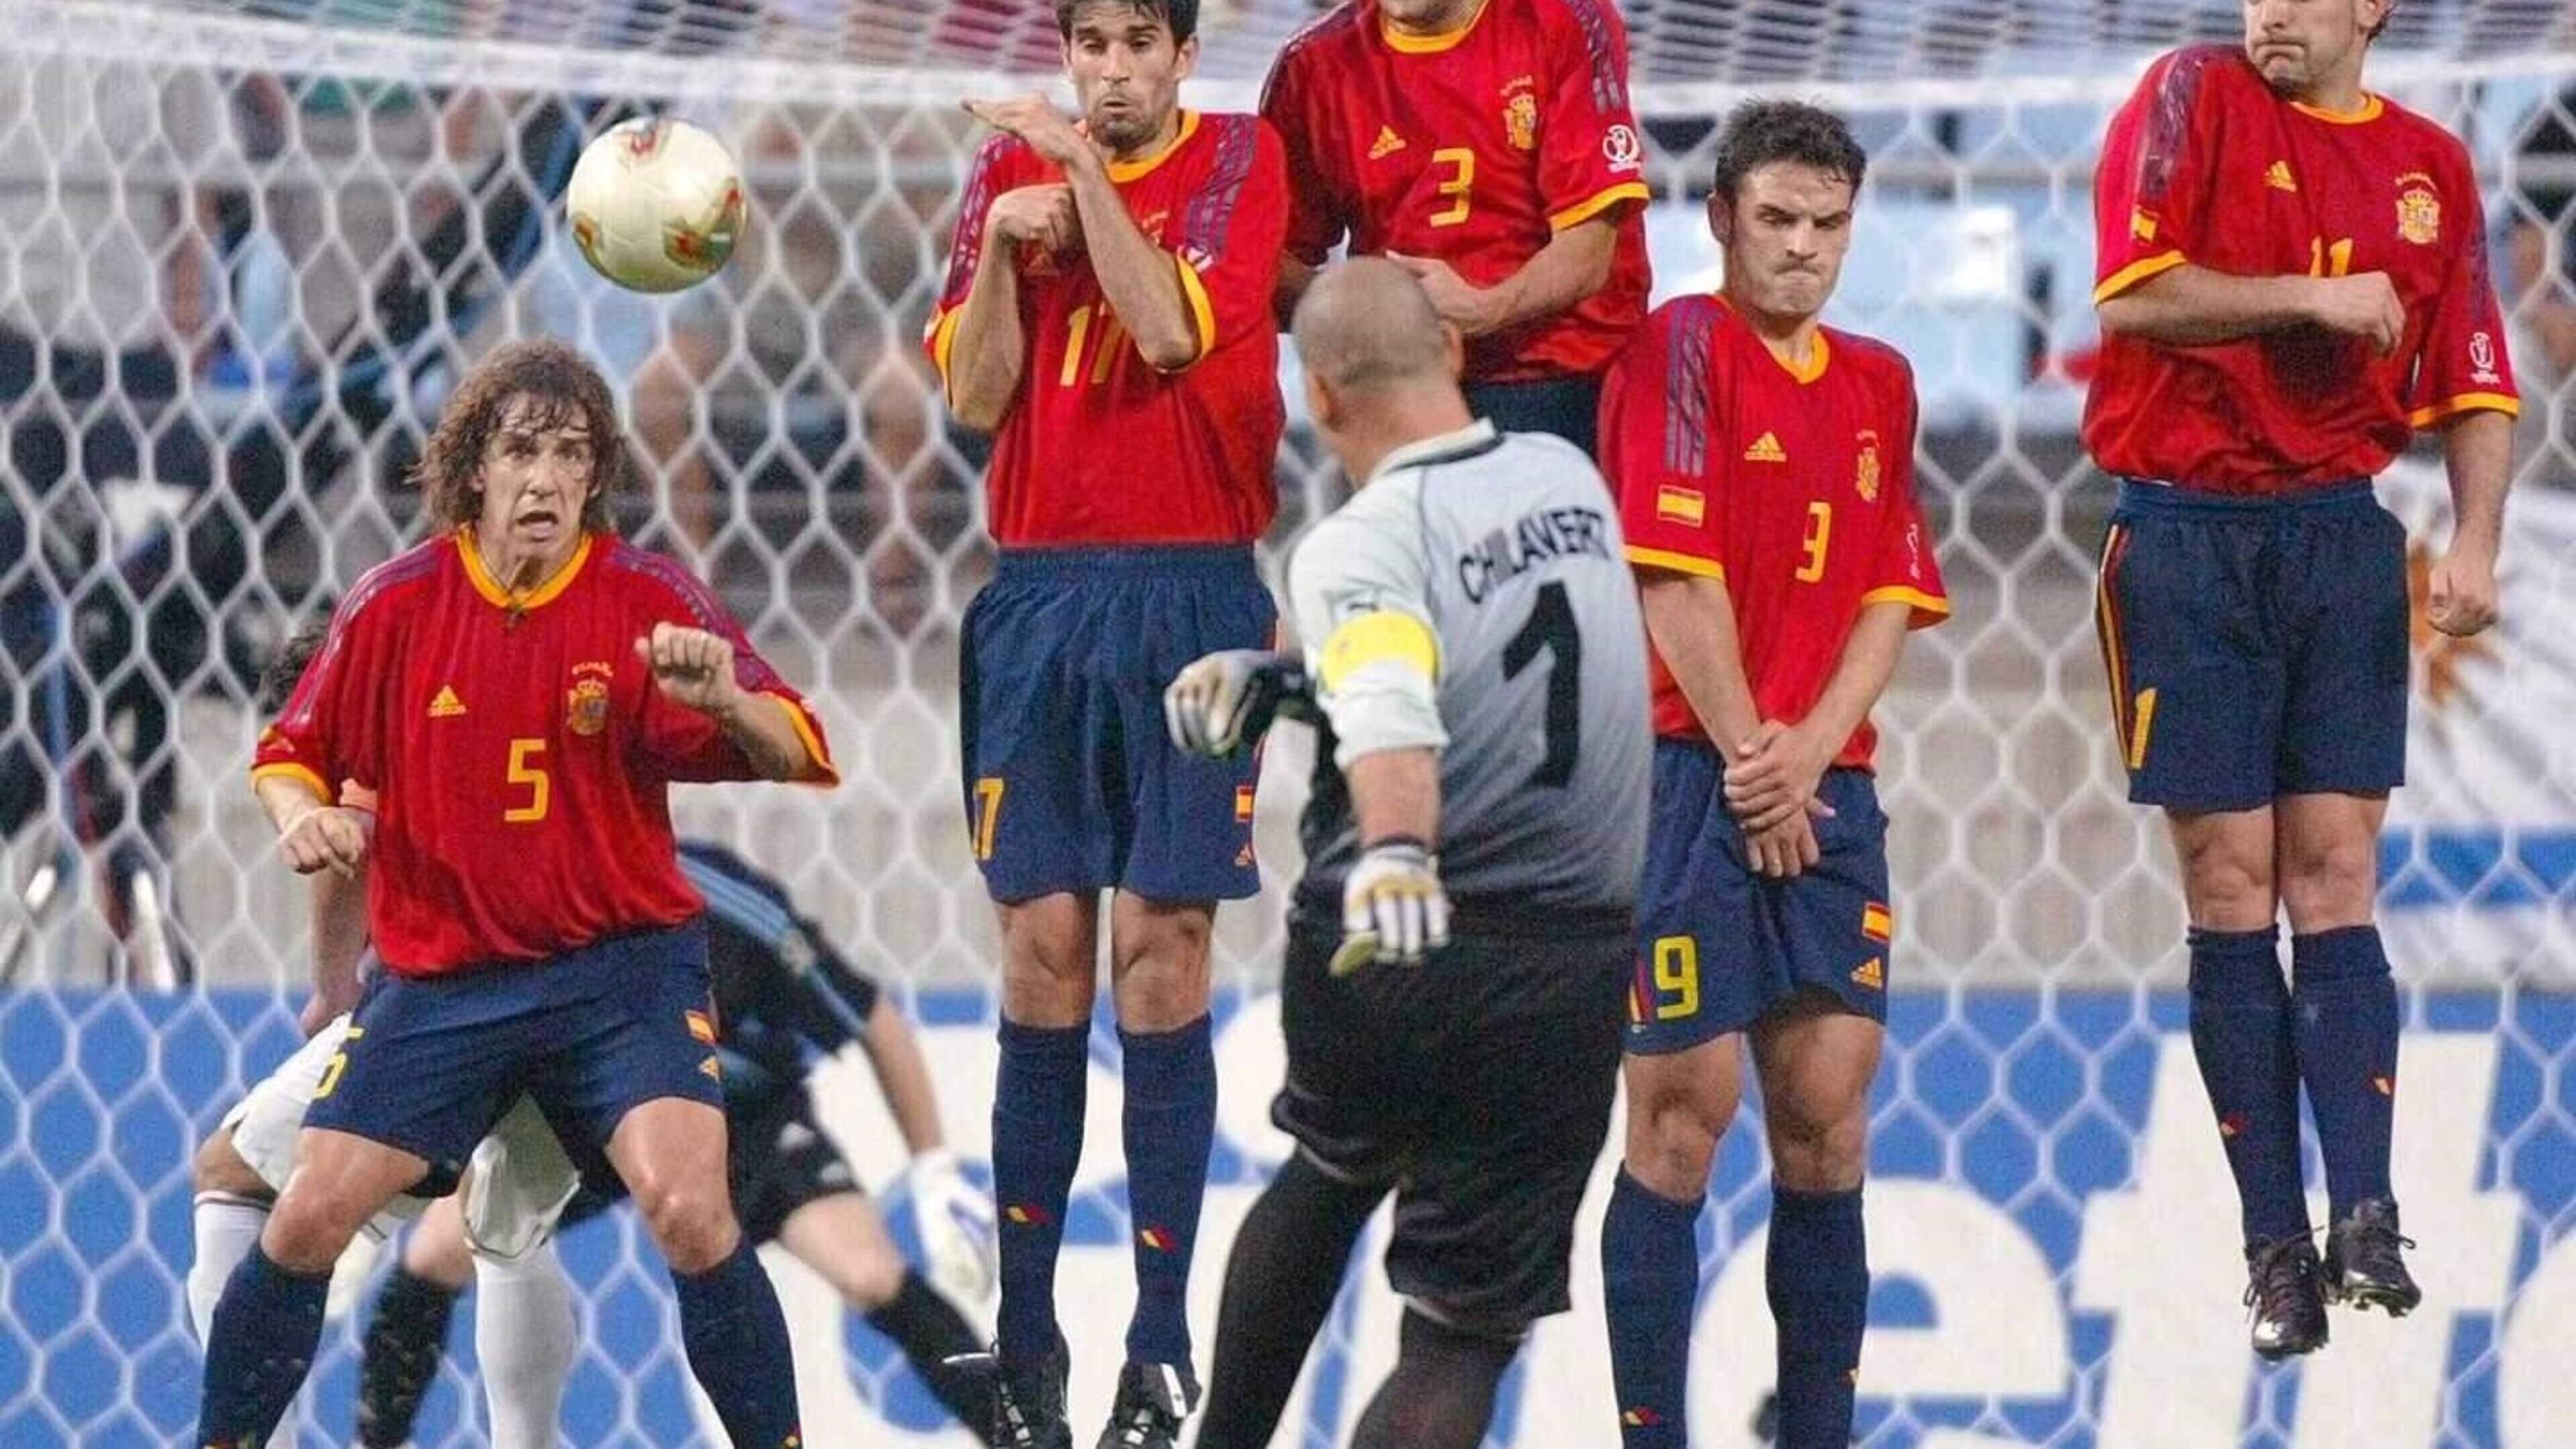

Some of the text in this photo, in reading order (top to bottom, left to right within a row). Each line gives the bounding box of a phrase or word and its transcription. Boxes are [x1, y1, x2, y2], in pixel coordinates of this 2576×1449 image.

[1430, 147, 1475, 227] 3
[2308, 235, 2353, 278] 11
[1795, 500, 1832, 583] 9
[1502, 580, 1582, 789] 1
[504, 738, 549, 822] 5
[1654, 935, 1699, 1020] 9
